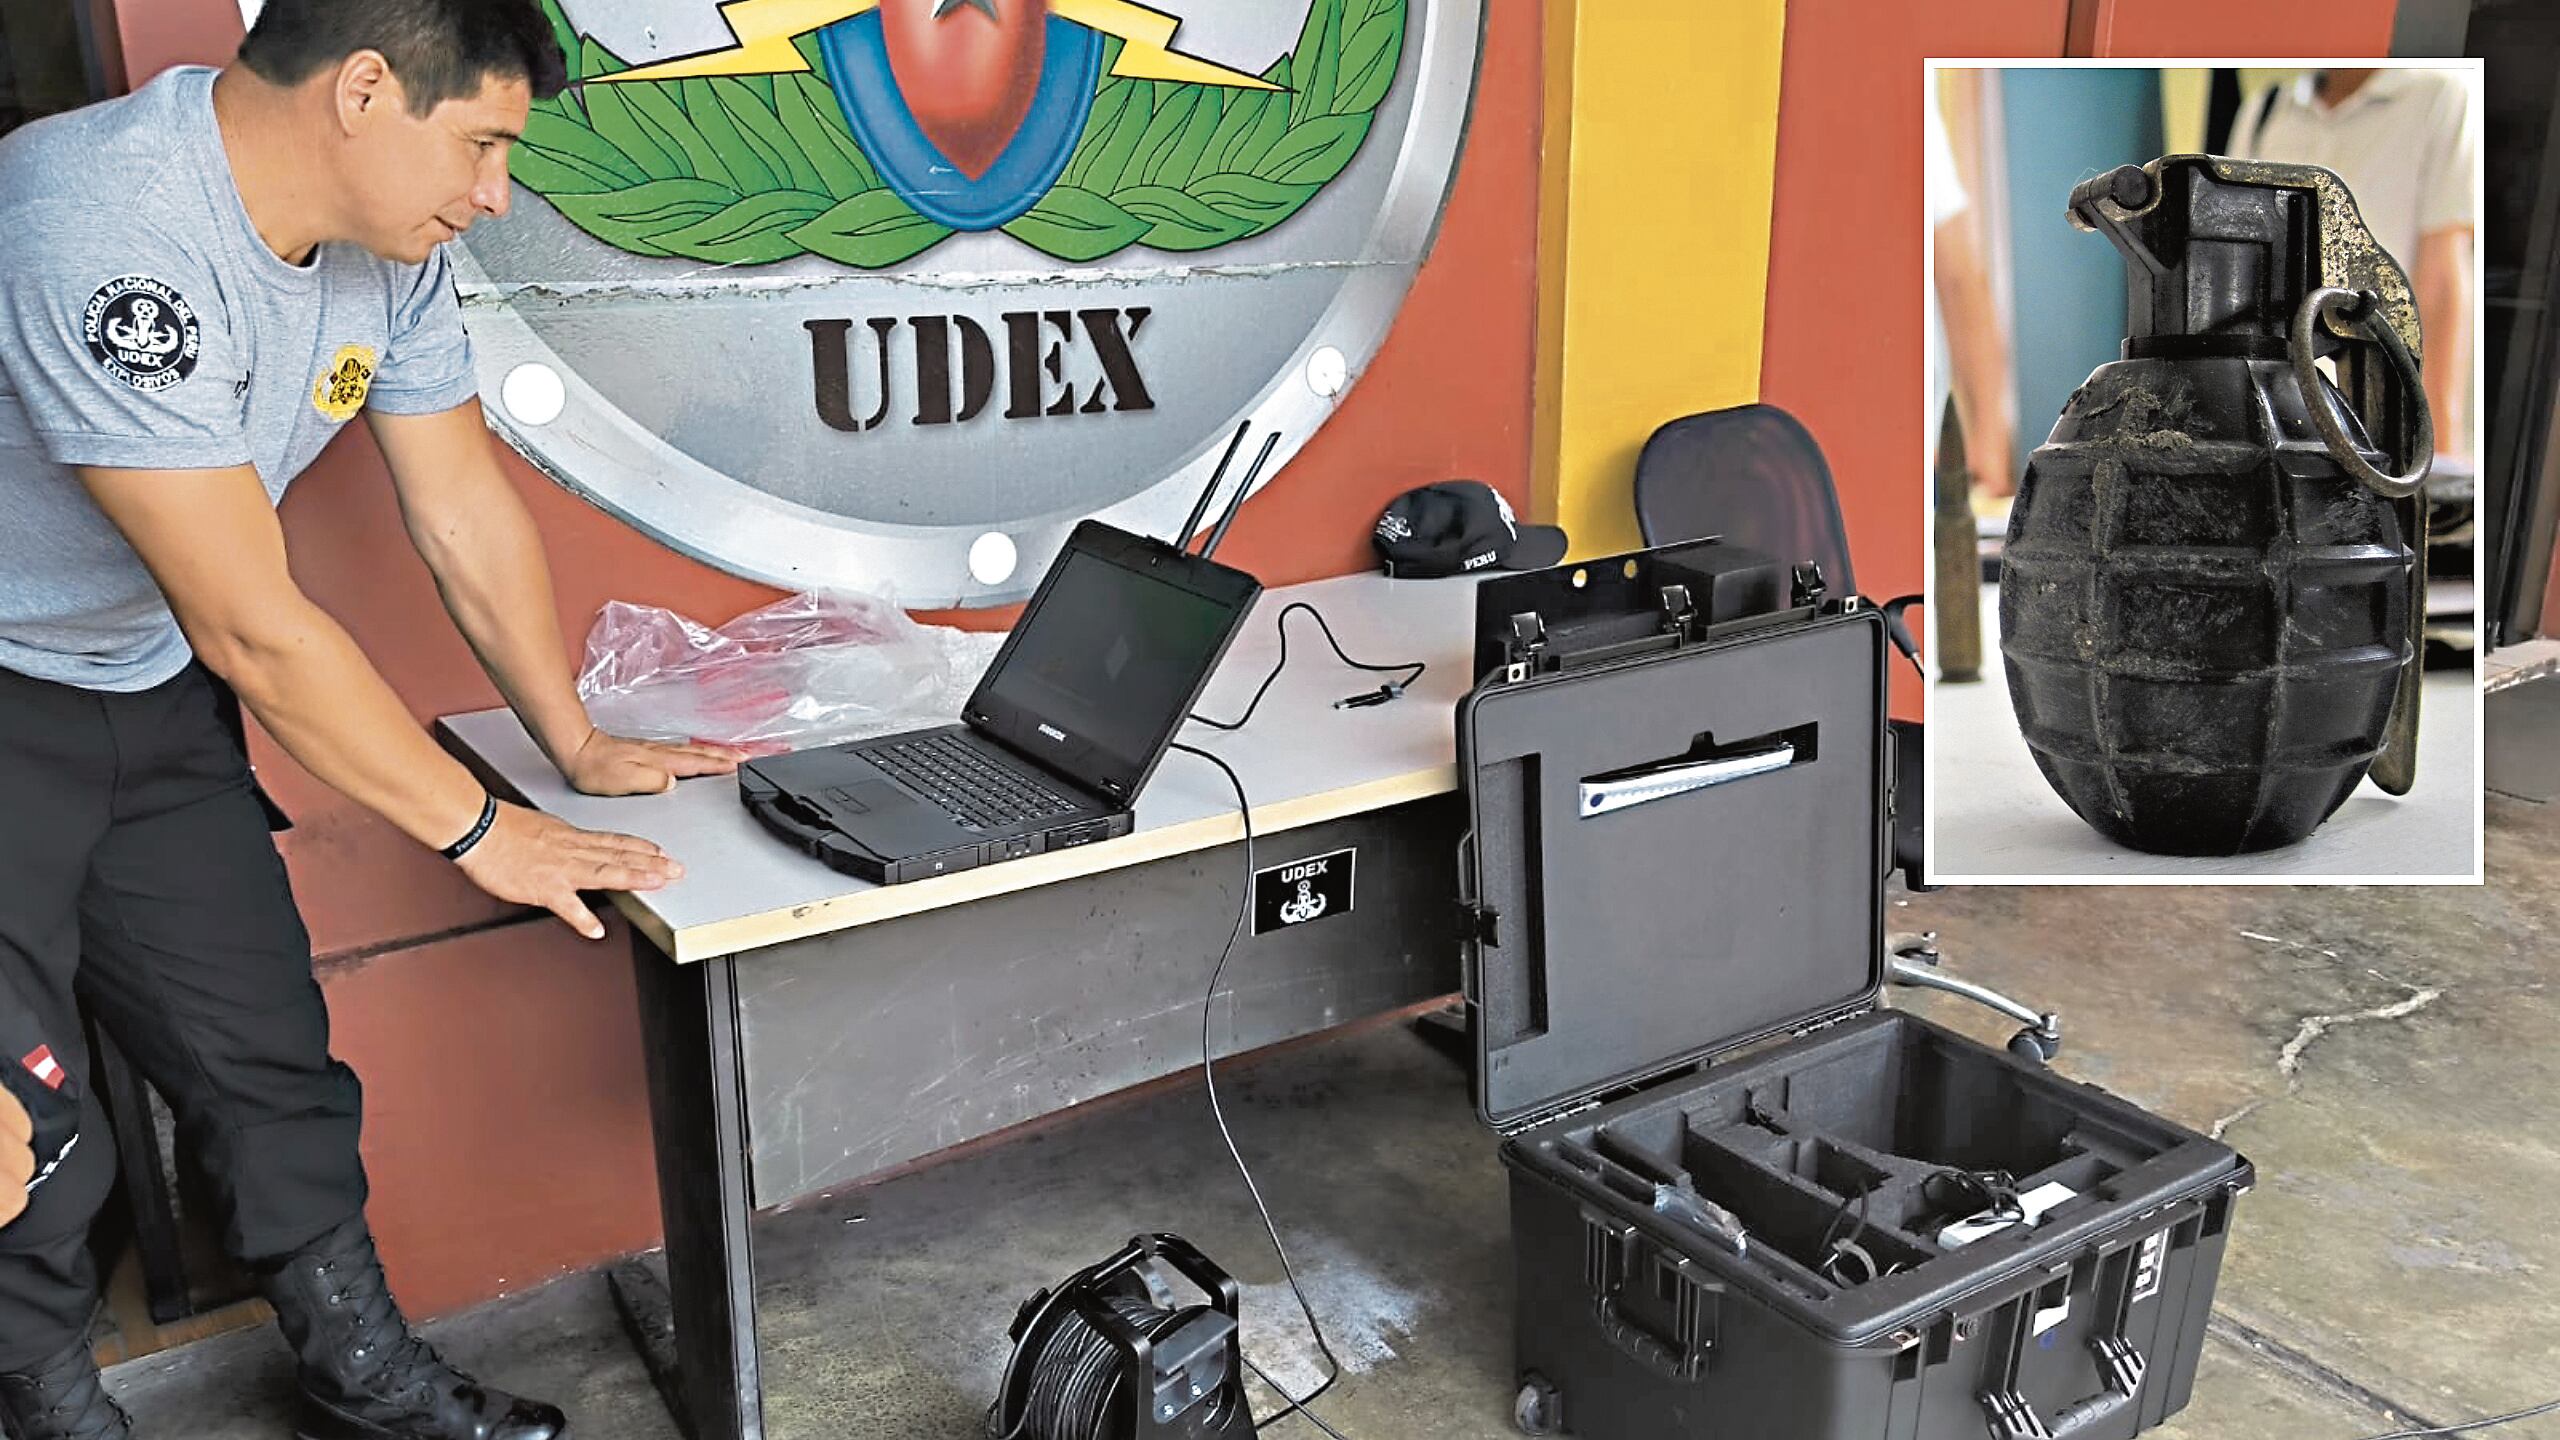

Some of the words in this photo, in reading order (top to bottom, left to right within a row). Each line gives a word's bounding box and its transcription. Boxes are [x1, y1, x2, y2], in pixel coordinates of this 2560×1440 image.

[85, 293, 108, 342] POLICIA
[106, 278, 173, 299] NACIONAL
[173, 300, 193, 324] DEL
[117, 349, 163, 367] UDEX
[803, 306, 1155, 433] UDEX
[1463, 550, 1497, 570] PERU
[1281, 860, 1328, 882] UDEX
